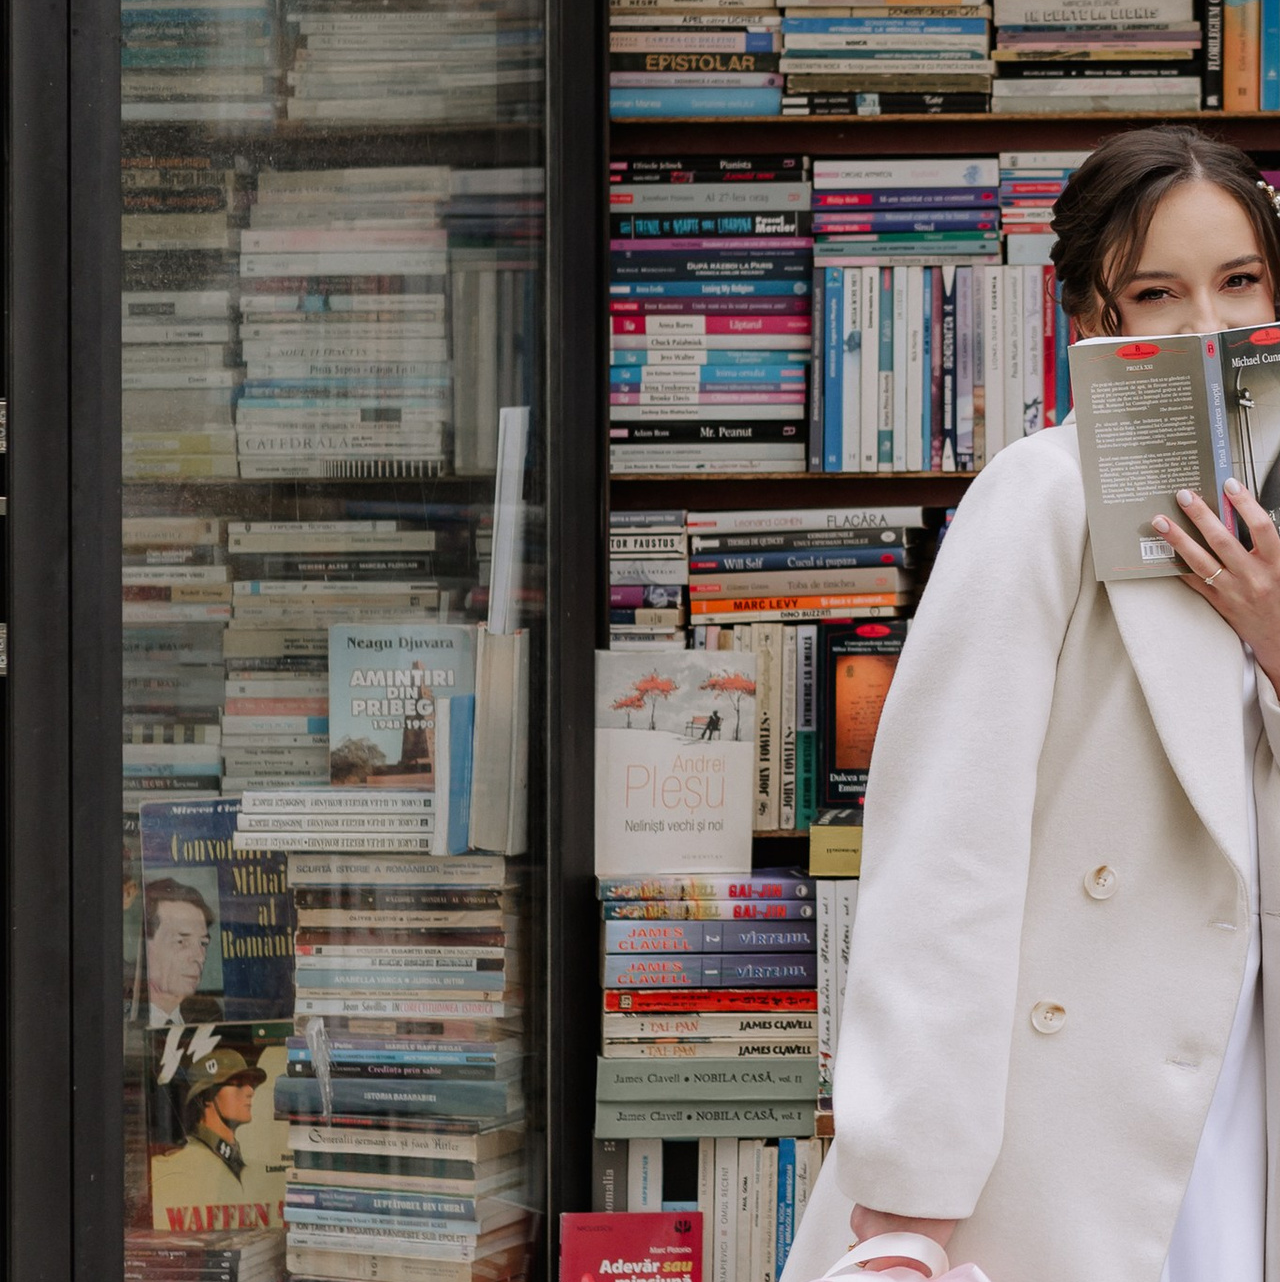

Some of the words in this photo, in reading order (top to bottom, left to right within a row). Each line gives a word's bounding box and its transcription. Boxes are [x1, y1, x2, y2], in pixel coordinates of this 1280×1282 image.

[1208, 7, 1222, 71] FLORILEGIUM
[646, 54, 755, 72] EPISTOLAR
[1232, 353, 1261, 368] Michael
[700, 427, 716, 438] Mr.
[718, 427, 752, 437] Peanut
[826, 512, 889, 528] FLACĂRA
[634, 537, 675, 549] FAUSTUS
[746, 557, 764, 569] Self
[733, 599, 766, 611] MARC
[768, 599, 798, 610] LEVY
[780, 611, 800, 619] DINO
[346, 637, 393, 653] Neagu
[398, 637, 454, 653] Djuvara
[350, 669, 454, 687] AMINTIRI
[386, 686, 419, 700] DIN
[352, 699, 434, 717] PRIBEG
[760, 717, 770, 767] FOWLES
[672, 754, 726, 773] Andrei
[624, 765, 725, 815] Pleșu
[758, 769, 770, 797] JOHN
[783, 783, 796, 811] JOHN
[667, 819, 694, 831] vechi
[708, 819, 724, 831] noi
[232, 864, 287, 896] Mihai
[728, 884, 782, 899] GAI-JIN
[258, 896, 276, 927] al
[732, 905, 788, 919] GAI-JIN
[627, 927, 684, 938] JAMES
[618, 939, 692, 951] CLAVELL
[626, 961, 683, 973] JAMES
[617, 974, 692, 985] CLAVELL
[739, 1021, 773, 1031] JAMES
[774, 1020, 813, 1031] CLAVELL
[738, 1045, 771, 1056] JAMES
[772, 1045, 812, 1056] CLAVELL
[614, 1073, 650, 1085] James
[650, 1073, 680, 1083] Clavell
[693, 1073, 738, 1083] NOBILA
[616, 1111, 646, 1122] James
[650, 1109, 683, 1121] Clavell
[696, 1110, 740, 1121] NOBILA
[166, 1202, 270, 1233] WAFFEN
[599, 1259, 660, 1274] Adevăr
[662, 1261, 692, 1273] sau
